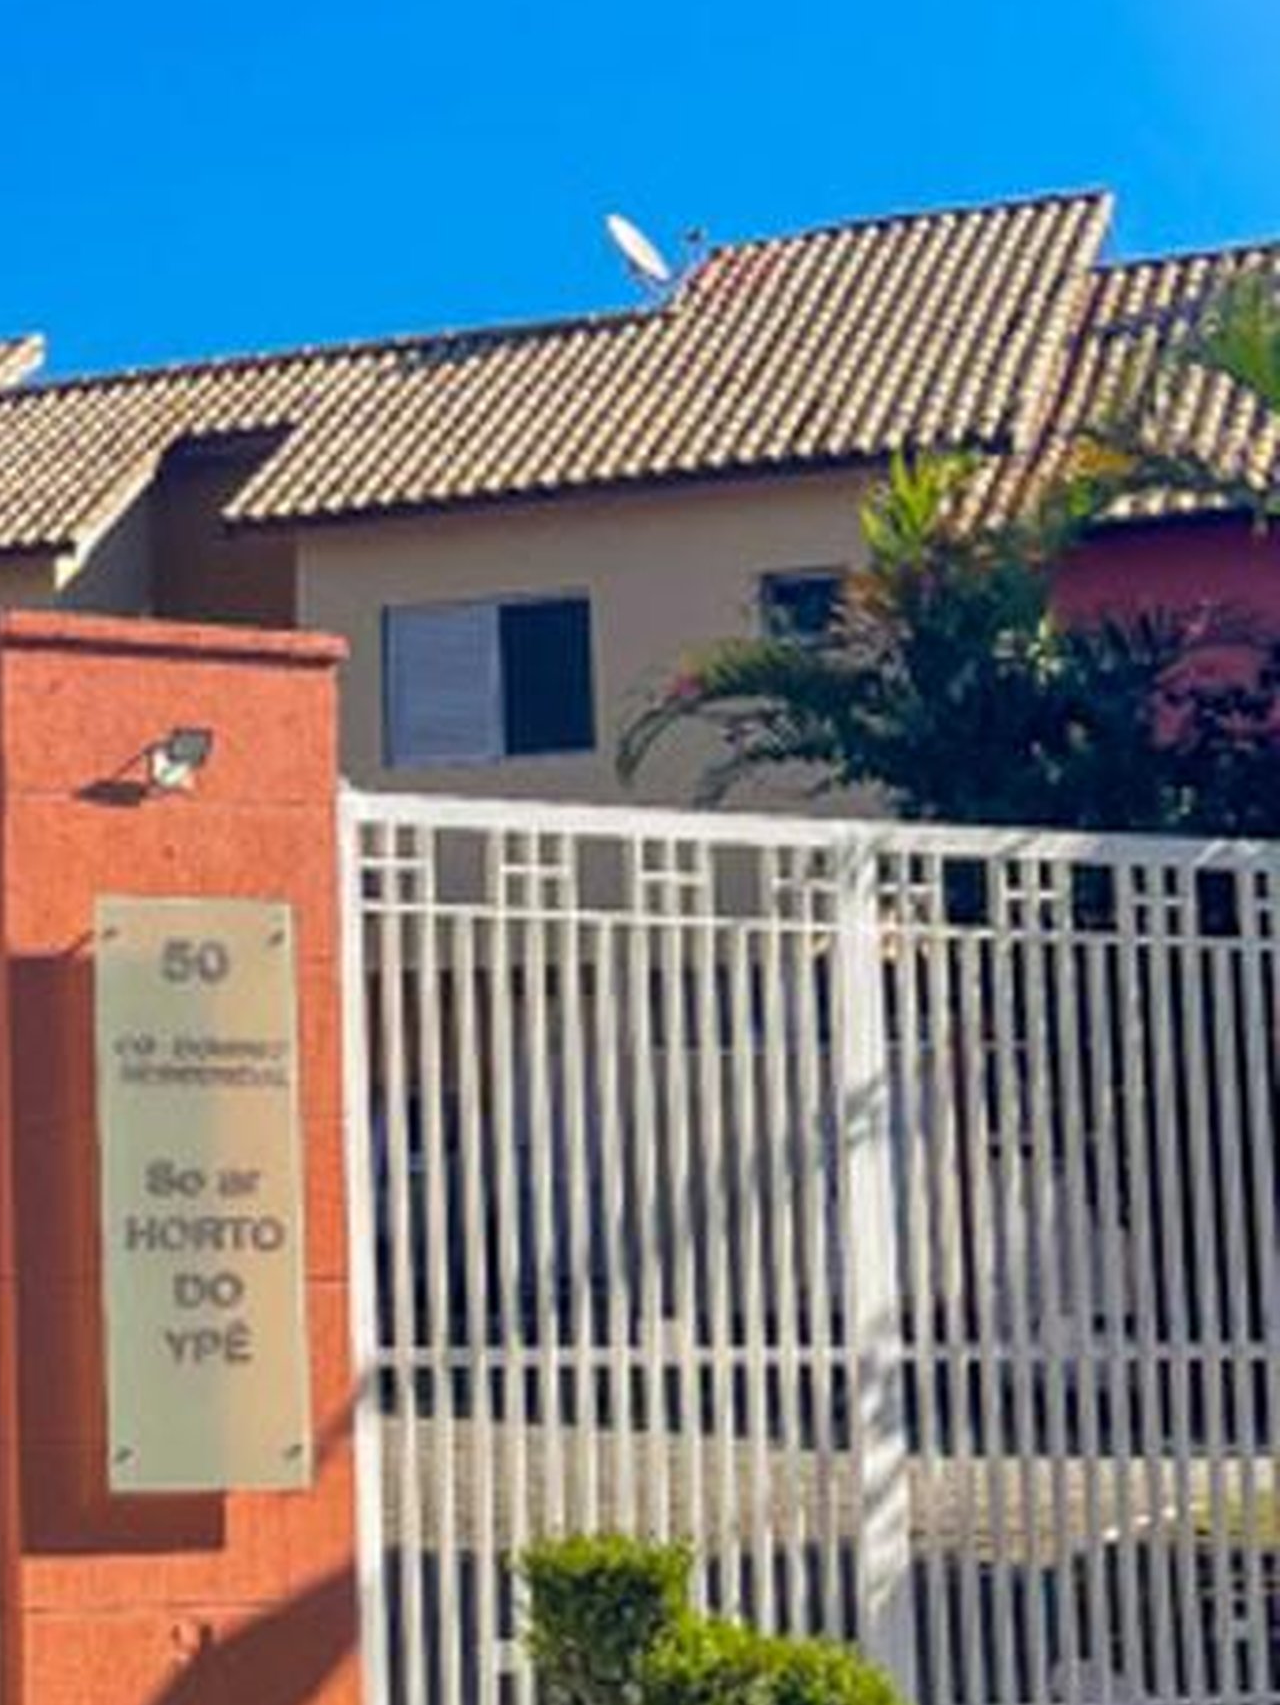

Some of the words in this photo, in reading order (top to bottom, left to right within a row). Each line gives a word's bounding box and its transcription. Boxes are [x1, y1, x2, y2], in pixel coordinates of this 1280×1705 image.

[161, 938, 230, 984] 50
[125, 1215, 284, 1252] HORTO
[173, 1271, 245, 1309] DO
[164, 1320, 253, 1364] YPÊ
